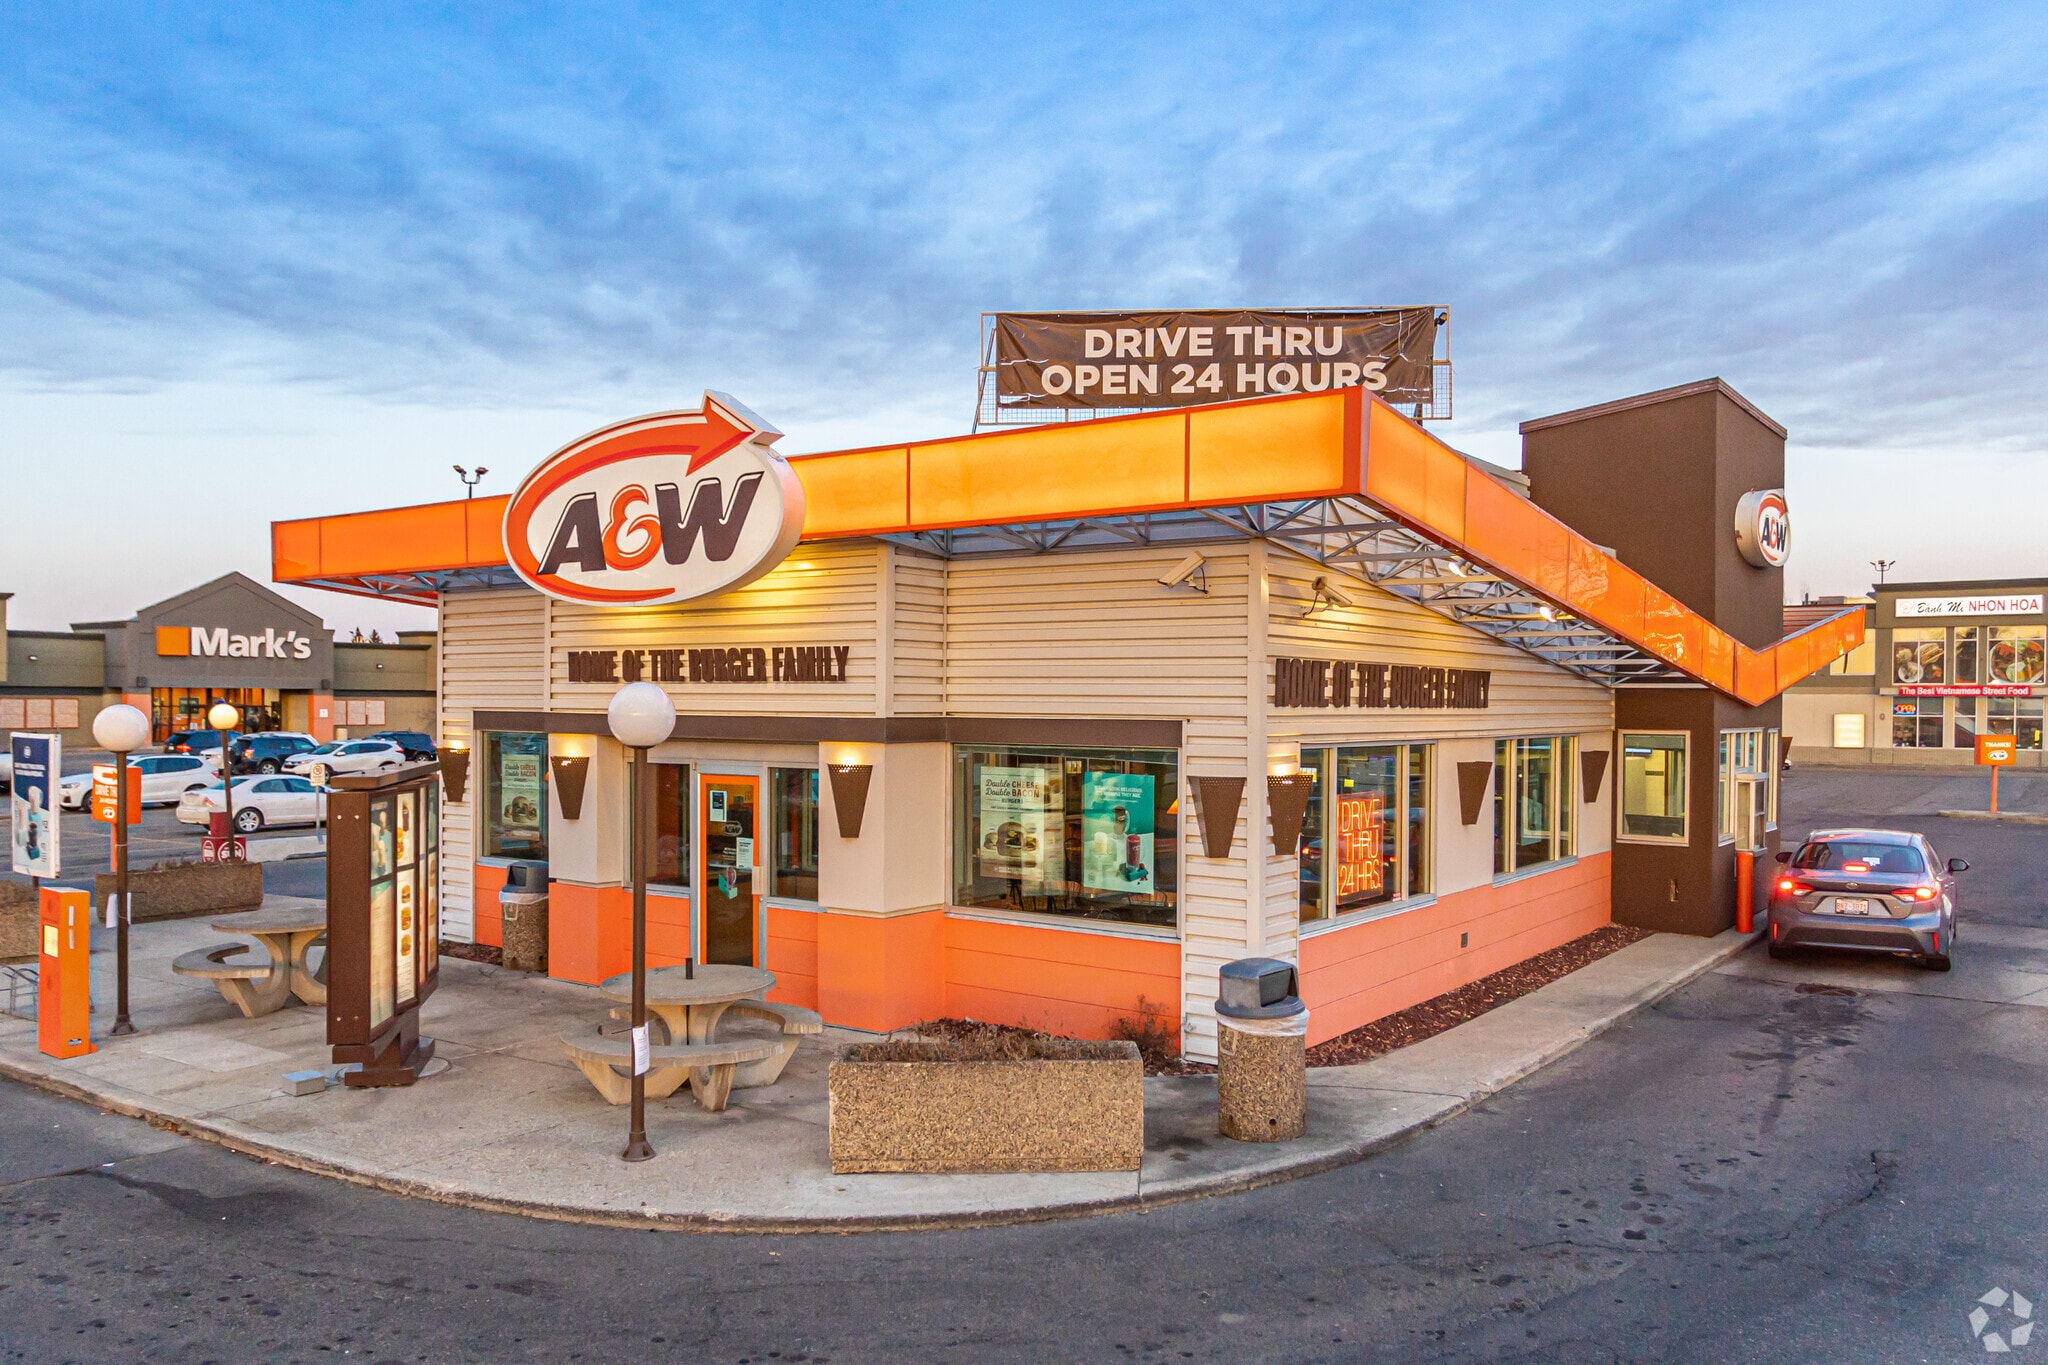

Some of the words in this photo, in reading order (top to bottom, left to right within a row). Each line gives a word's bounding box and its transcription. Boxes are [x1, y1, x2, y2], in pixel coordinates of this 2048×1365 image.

[1085, 326, 1214, 359] DRIVE
[1225, 325, 1344, 357] THRU
[1041, 364, 1158, 396] OPEN
[1170, 362, 1224, 395] 24
[1236, 361, 1388, 393] HOURS
[536, 470, 765, 576] A&W
[1760, 514, 1788, 553] A&W
[1968, 599, 2006, 612] NHON
[2010, 598, 2039, 611] HOA
[191, 626, 312, 659] Mark's
[568, 650, 619, 683] HOME
[622, 650, 645, 683] OF
[648, 649, 685, 682] THE
[688, 647, 767, 682] BURGER
[772, 646, 850, 682] FAMILY
[1274, 658, 1331, 708] HOME
[1332, 660, 1356, 708] OF
[1357, 663, 1389, 708] THE
[1389, 665, 1445, 709] BURGER
[1447, 668, 1491, 709] FAMILY
[1901, 686, 1915, 695] The
[1917, 686, 1934, 695] Best
[1936, 686, 1980, 695] Vietnamese
[1982, 686, 2006, 695] Street
[2007, 686, 2029, 695] Food
[95, 783, 110, 797] DRIVE
[985, 779, 1010, 788] Double
[1011, 780, 1040, 790] CHEESE
[985, 787, 1010, 797] Double
[1011, 788, 1040, 798] BACON
[1341, 799, 1380, 832] DRIVE
[1343, 829, 1380, 862] THRU
[1340, 865, 1355, 896] 24
